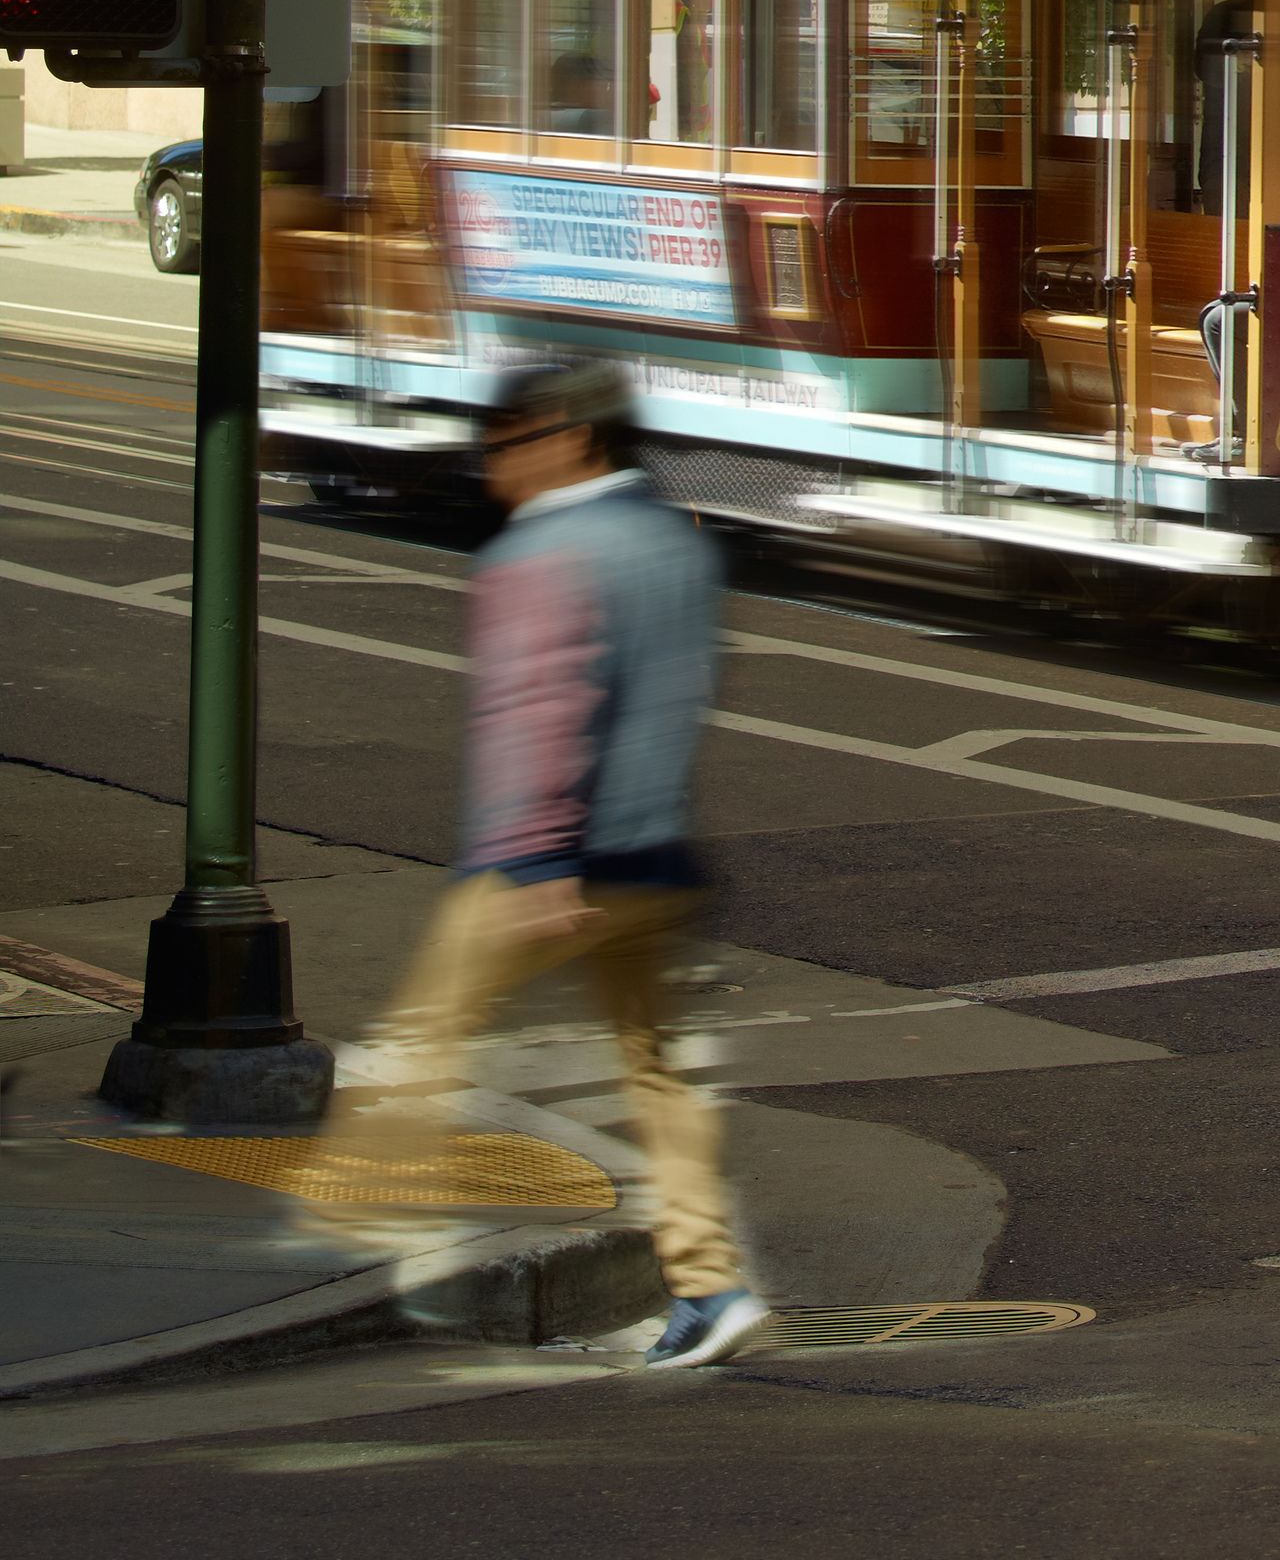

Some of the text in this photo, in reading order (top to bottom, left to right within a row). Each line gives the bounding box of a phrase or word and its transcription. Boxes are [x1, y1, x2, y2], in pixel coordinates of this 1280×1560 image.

[511, 183, 718, 230] SPECTACULAR END OF
[514, 216, 721, 268] BAY VIEWS! PIER 39
[538, 273, 662, 308] BUBBAGUMP.COM
[634, 360, 729, 397] MUNICIPAL
[738, 374, 819, 409] RAILWAY
